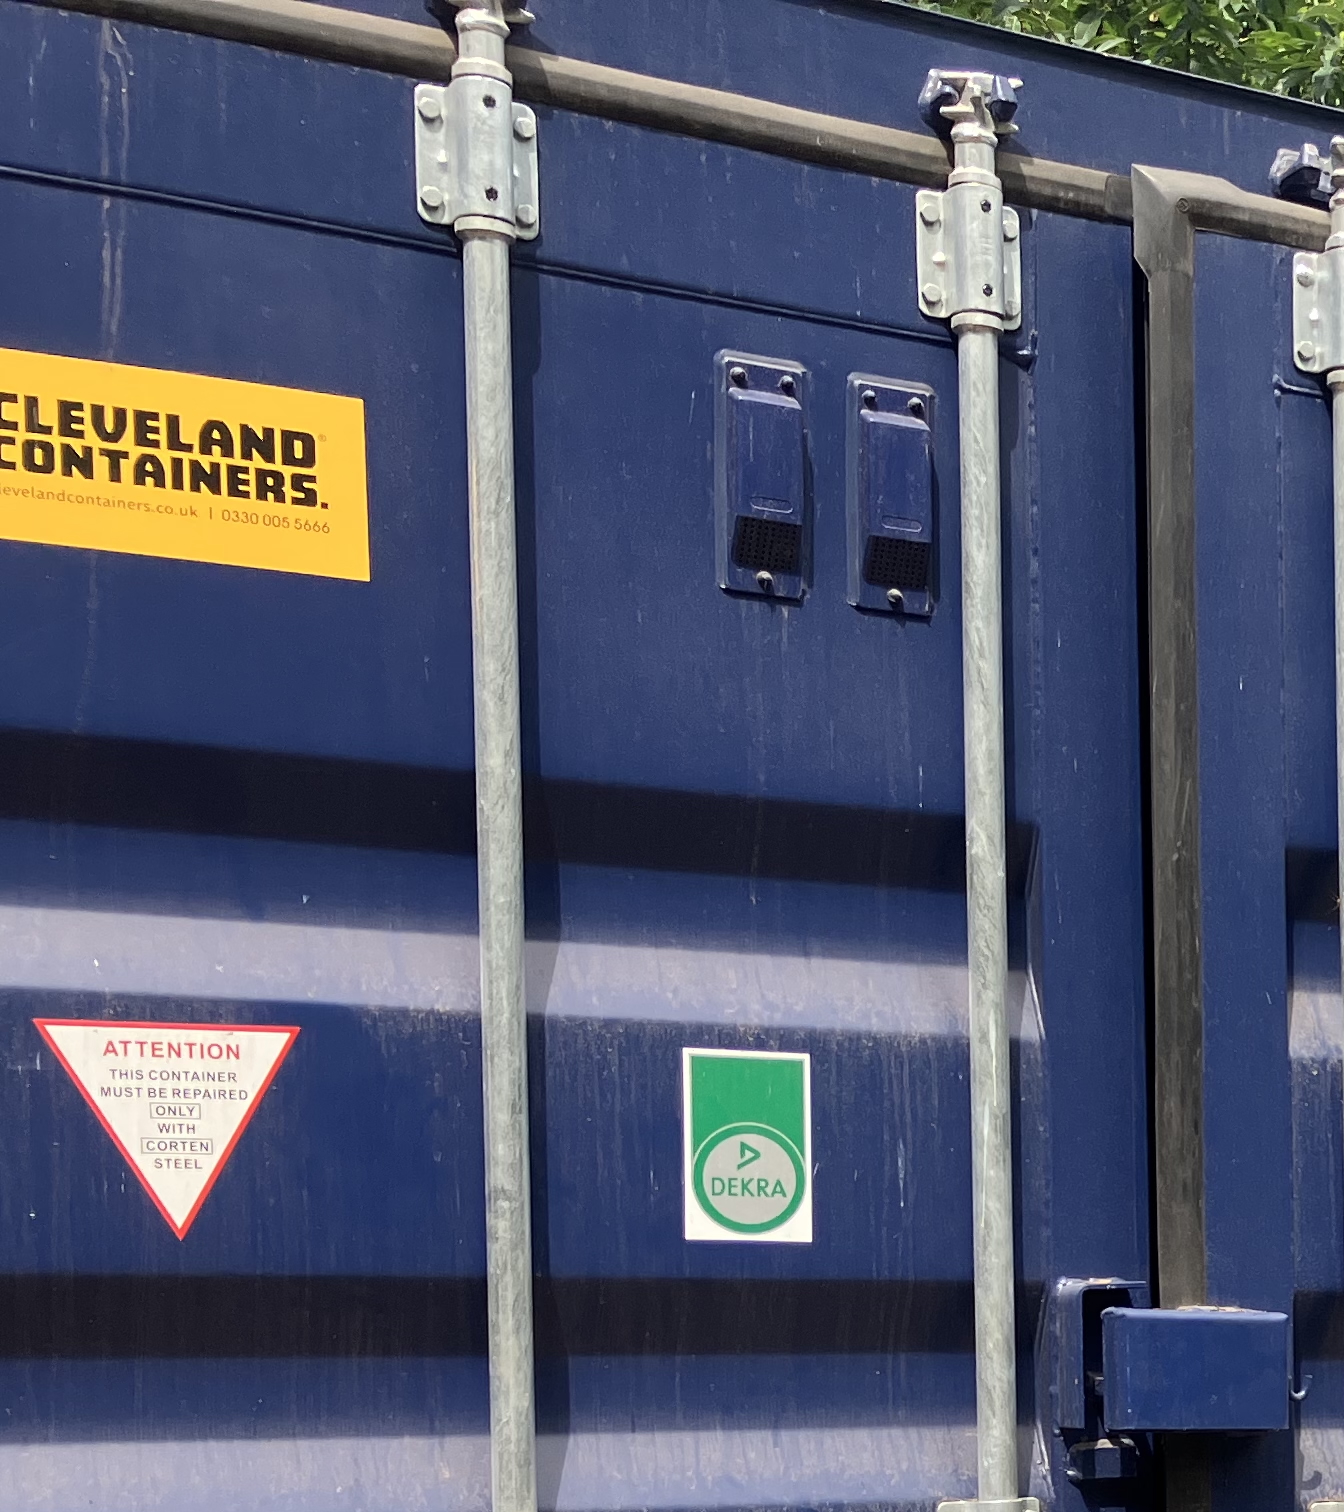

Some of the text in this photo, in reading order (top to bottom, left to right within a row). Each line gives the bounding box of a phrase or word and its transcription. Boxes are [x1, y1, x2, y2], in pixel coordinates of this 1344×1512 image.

[0, 391, 316, 469] CLEVELAND
[0, 435, 330, 510] CONTAINERS.
[221, 509, 260, 526] 0330
[262, 514, 291, 530] 005
[293, 517, 331, 534] 5666
[102, 1040, 241, 1061] ATTENTION
[109, 1069, 238, 1083] THIS CONTAINER
[100, 1086, 249, 1101] MUST BE REPAIRED
[155, 1105, 196, 1117] ONLY
[157, 1123, 196, 1135] WITH
[146, 1140, 210, 1152] CORTEN
[153, 1158, 203, 1170] STEEL
[711, 1177, 788, 1198] DEKRA
